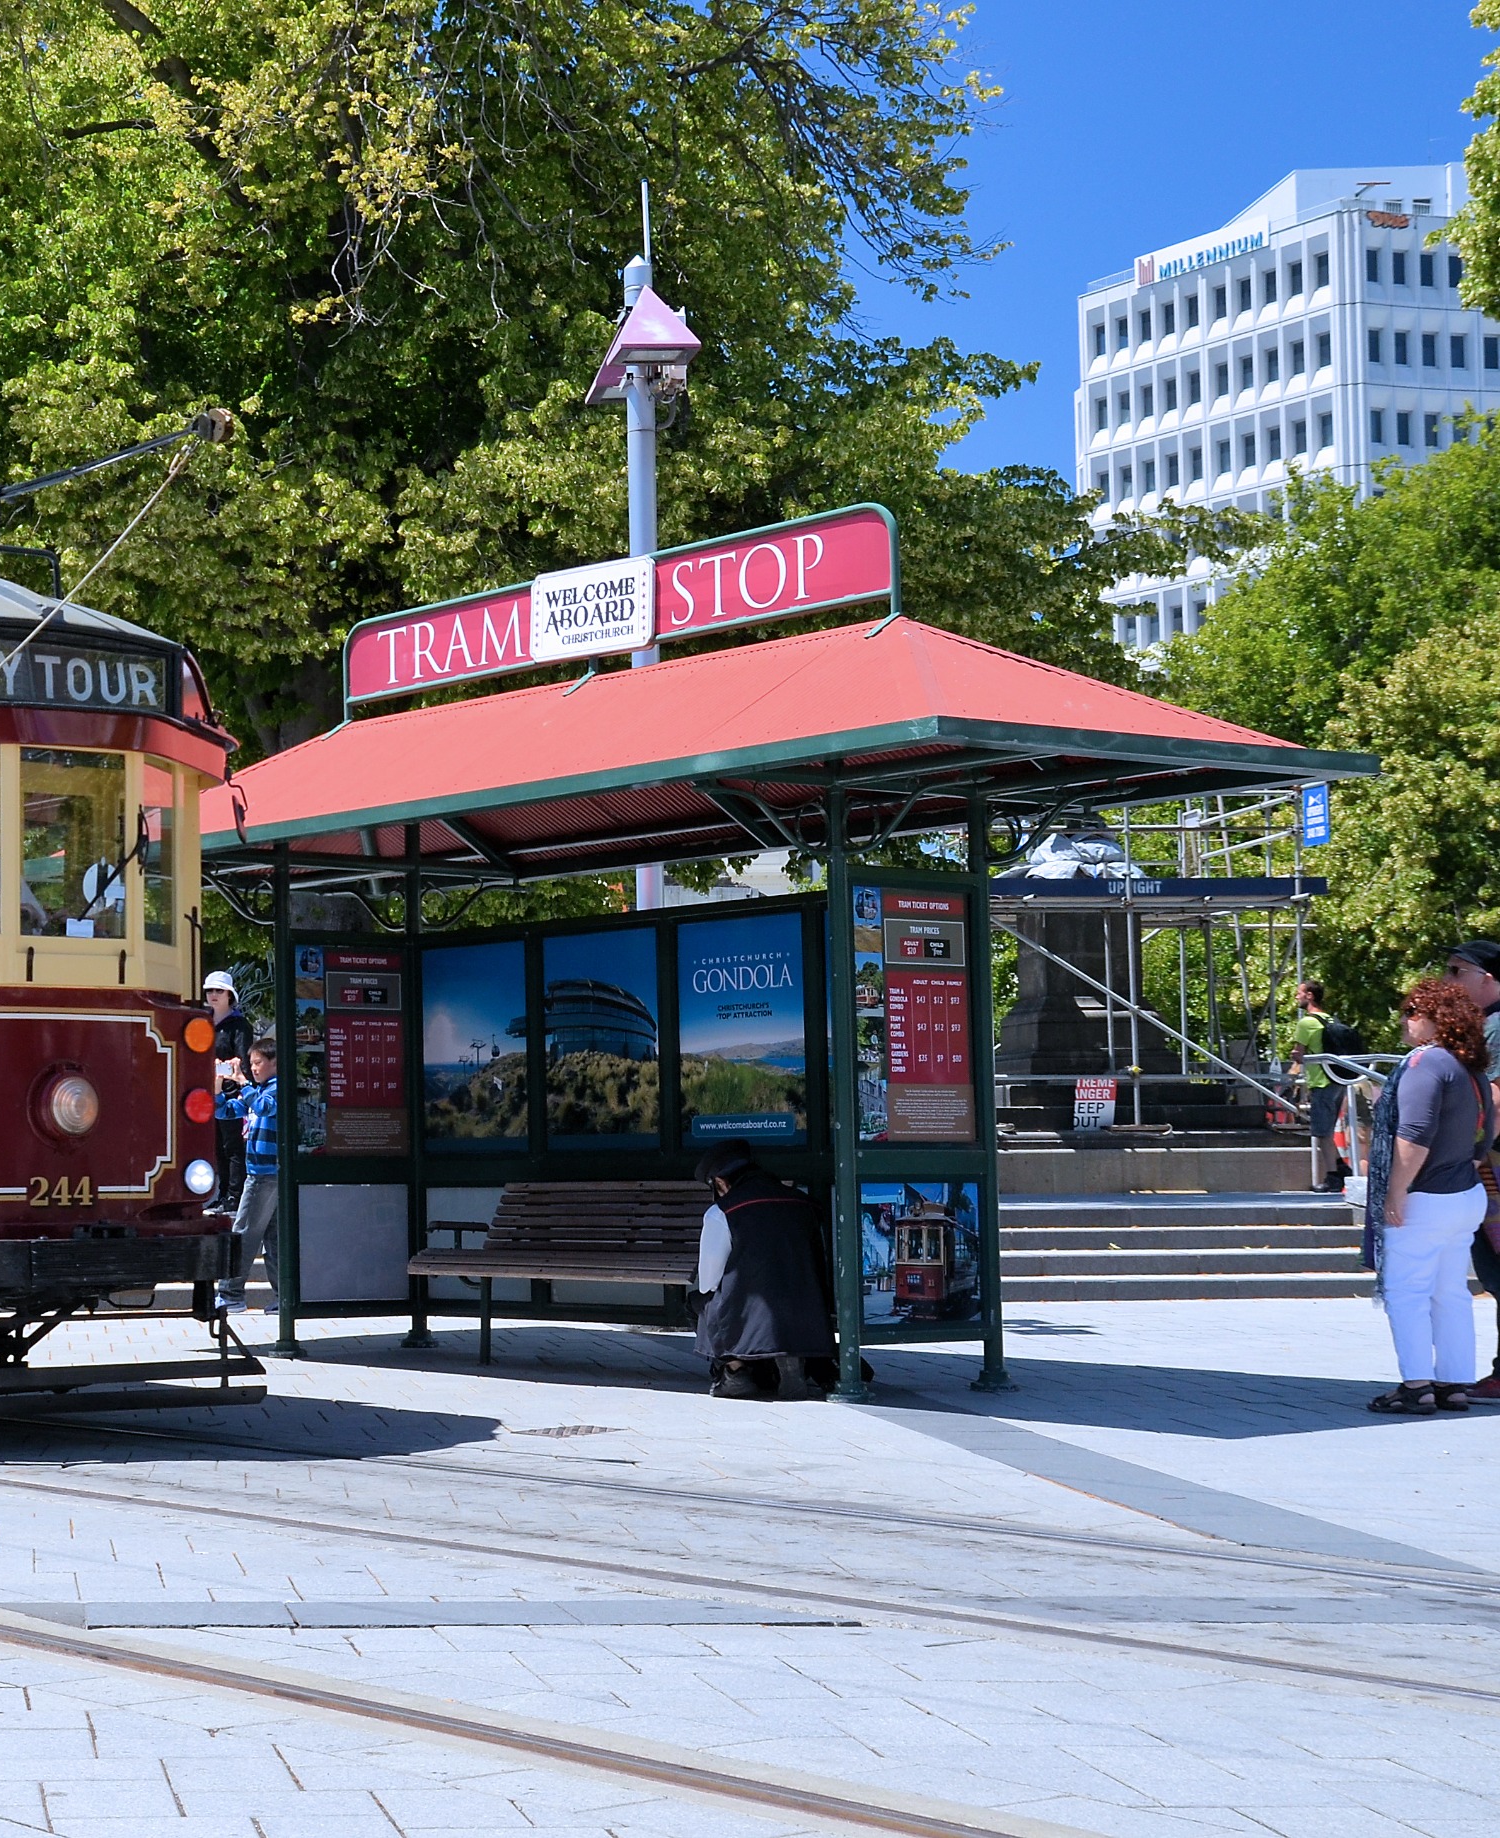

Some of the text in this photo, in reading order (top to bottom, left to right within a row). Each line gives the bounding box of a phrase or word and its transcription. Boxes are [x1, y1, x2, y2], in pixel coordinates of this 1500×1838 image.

[1159, 231, 1263, 279] MILLENNIUM
[545, 577, 635, 609] WELCOME
[377, 533, 824, 685] TRAM STOP
[544, 598, 635, 636] ABOARD
[561, 625, 634, 645] CHRISTCHURCH
[34, 654, 158, 706] TOUR
[1108, 881, 1162, 894] UPIGHT
[898, 900, 949, 910] TRAM TICKET OPTIONS
[909, 926, 940, 935] TRAM PRICES
[701, 952, 782, 965] CHRISTCHURCH
[692, 963, 794, 994] GONDOLA
[717, 1002, 770, 1012] CHRISTCHURCH'S
[733, 1010, 773, 1019] ATTRACTION
[1075, 1102, 1105, 1114] EEP
[700, 1120, 787, 1130] www.welcomeaboard.co.nz
[29, 1176, 94, 1206] 244
